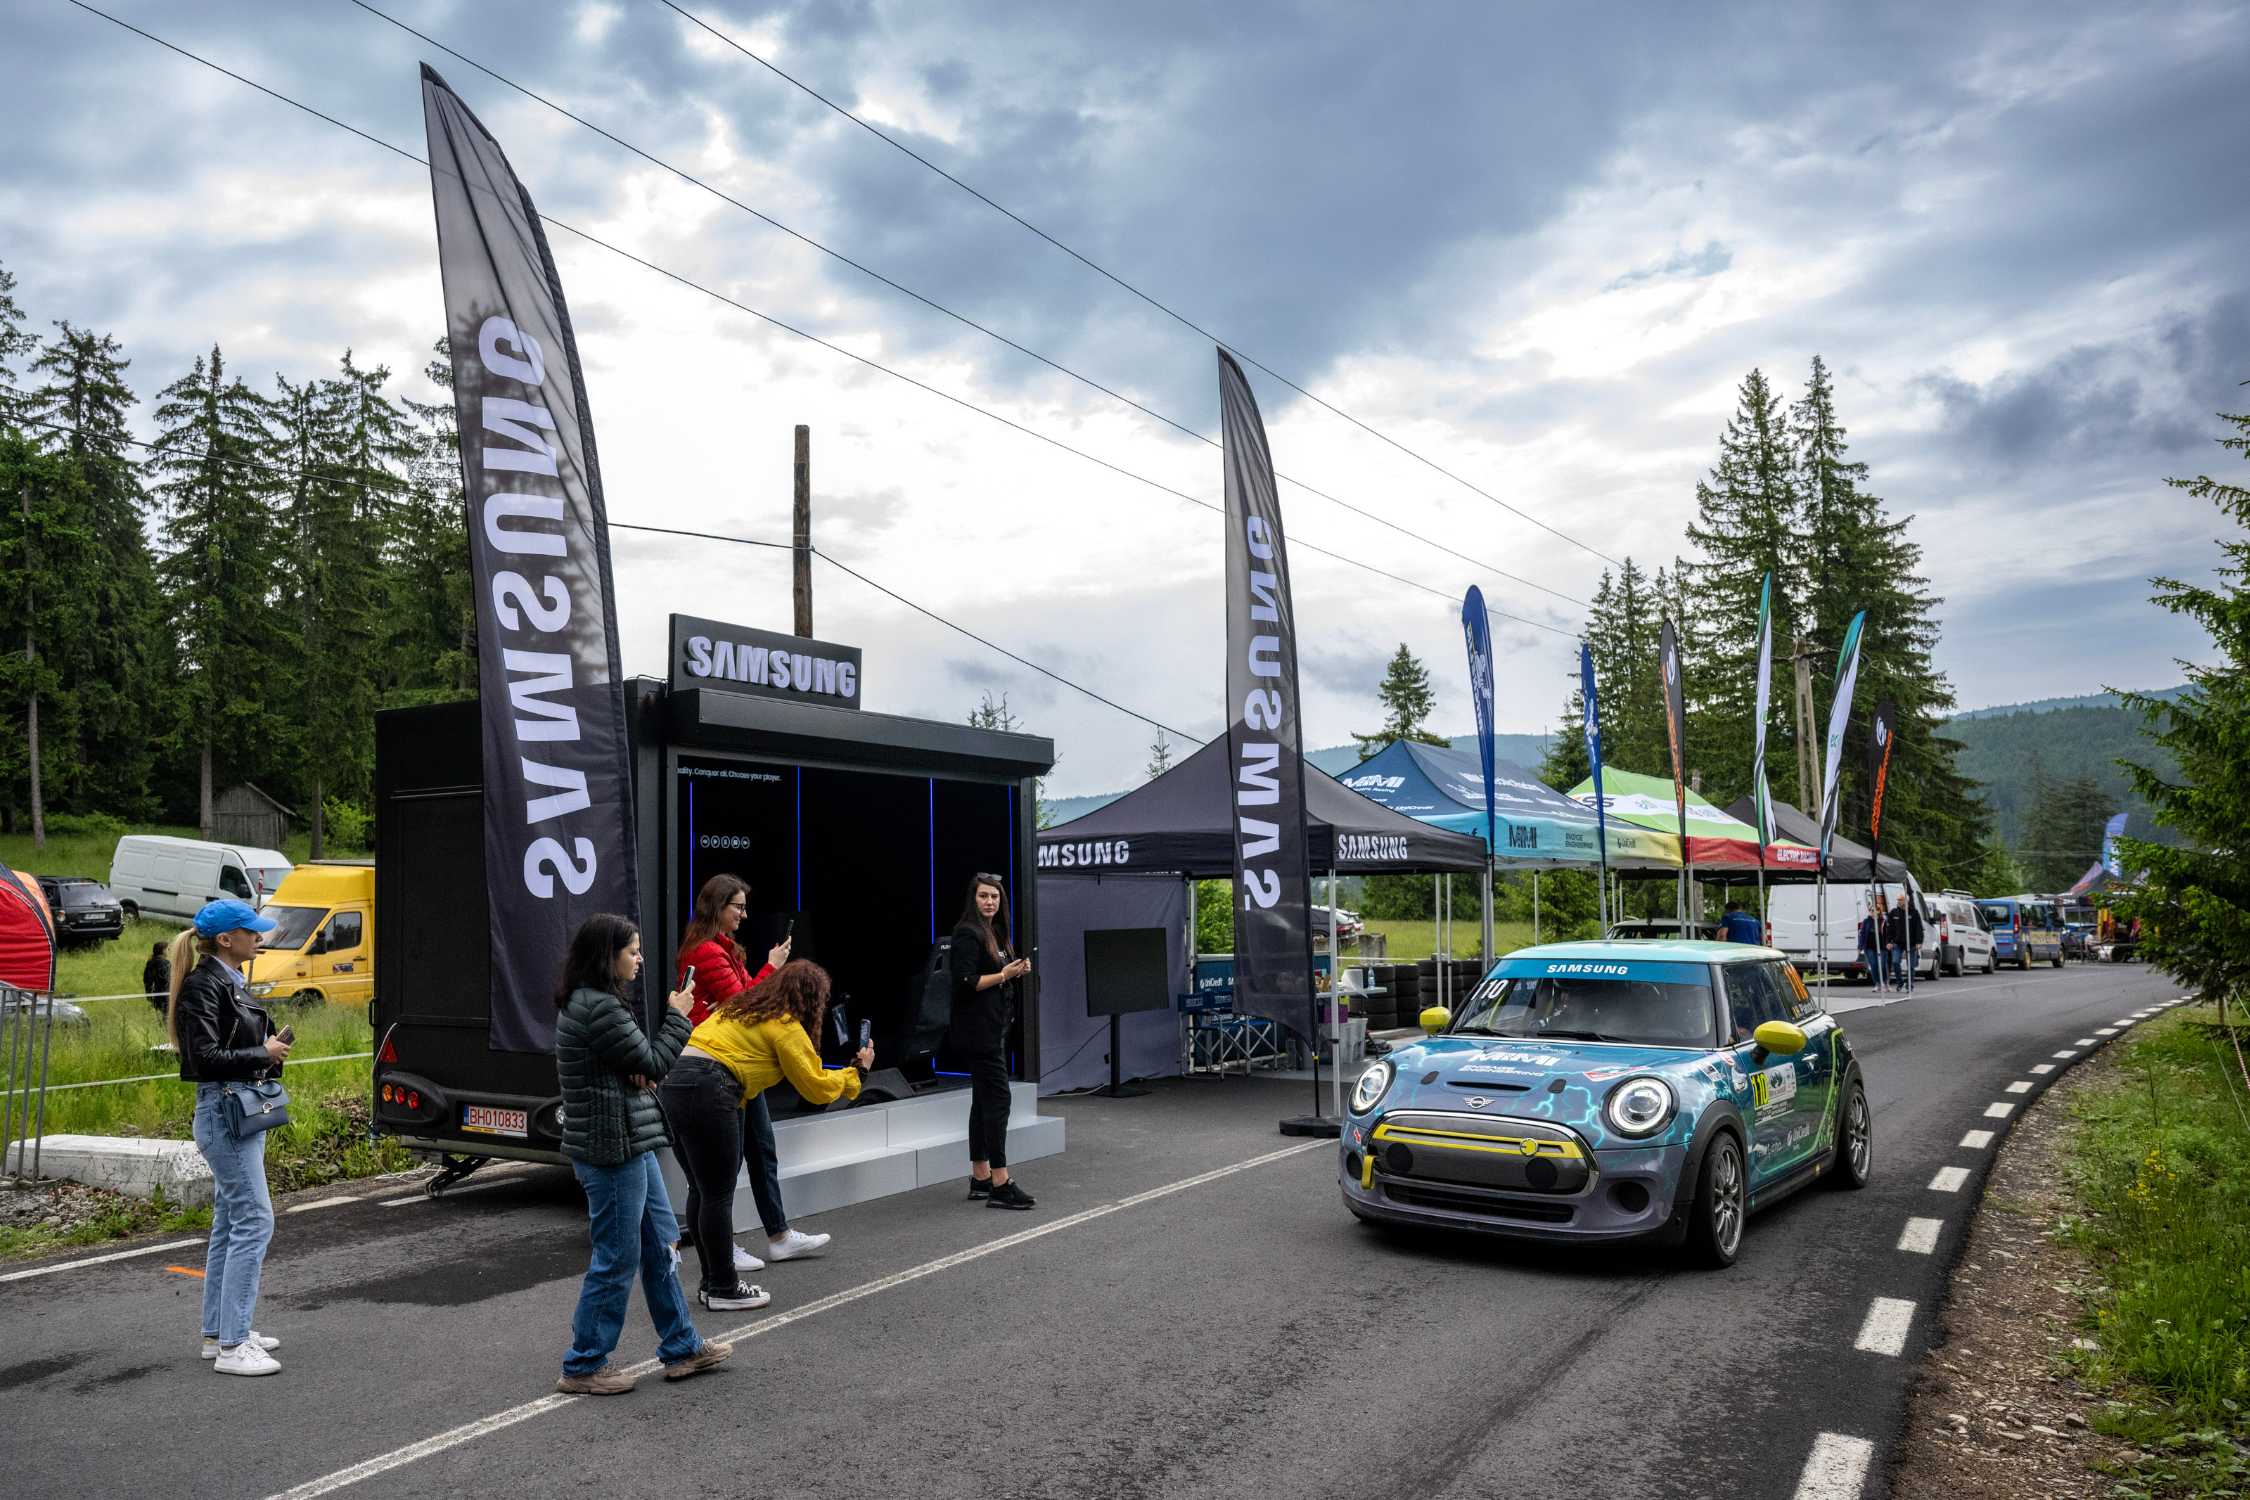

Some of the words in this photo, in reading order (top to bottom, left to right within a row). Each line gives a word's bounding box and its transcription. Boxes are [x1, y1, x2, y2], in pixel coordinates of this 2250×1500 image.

[687, 636, 856, 698] SAMSUNG
[728, 770, 749, 778] Choose
[1338, 834, 1408, 860] SAMSUNG
[1547, 964, 1628, 975] SAMSUNG
[1471, 979, 1510, 1001] 110
[1751, 1072, 1769, 1107] 110
[470, 1108, 525, 1130] BH010833
